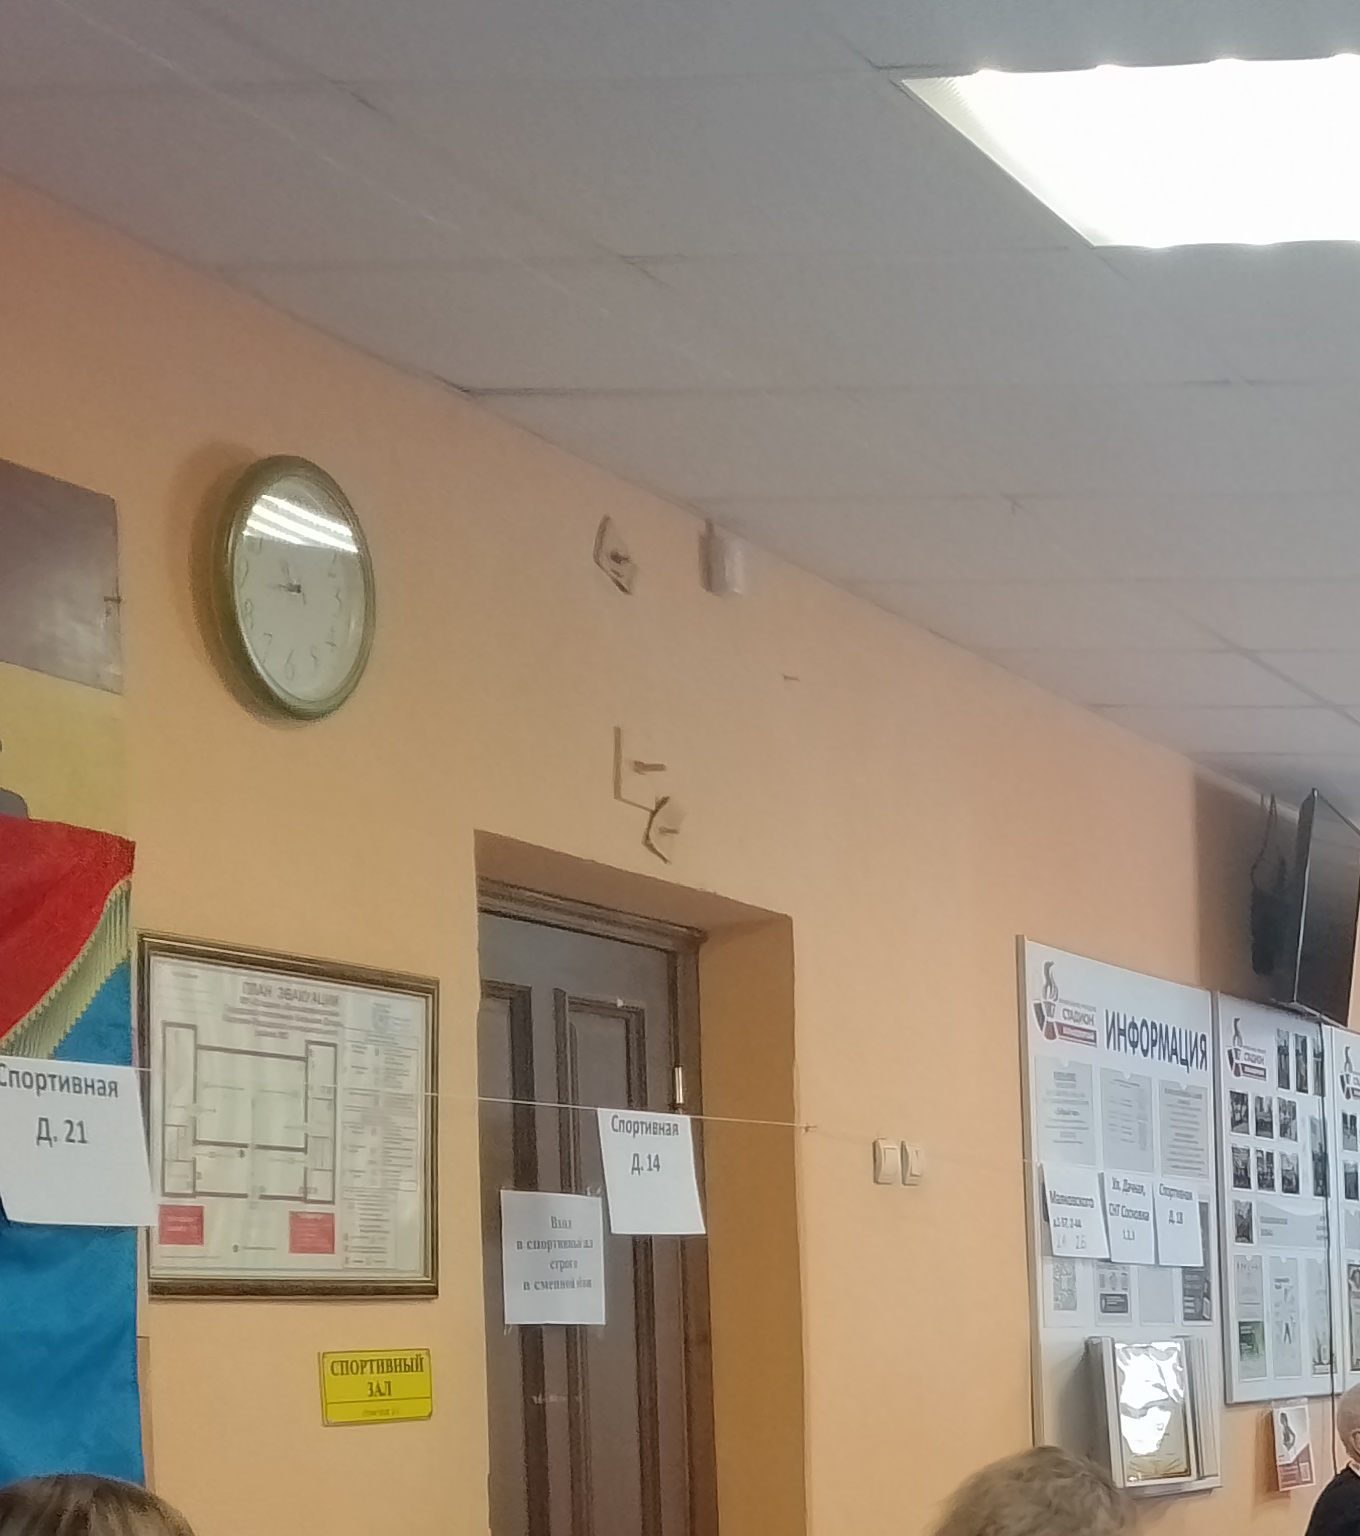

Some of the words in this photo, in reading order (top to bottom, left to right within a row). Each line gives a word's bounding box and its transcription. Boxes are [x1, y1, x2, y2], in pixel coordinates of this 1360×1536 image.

[1105, 1008, 1208, 1074] ИНФОРМАЦИЯ
[63, 1119, 89, 1144] 21
[610, 1114, 680, 1138] Спортивная
[646, 1153, 661, 1173] 14
[330, 1353, 424, 1376] СПОРТИВНЫЙ
[367, 1380, 393, 1397] ЗАЛ
